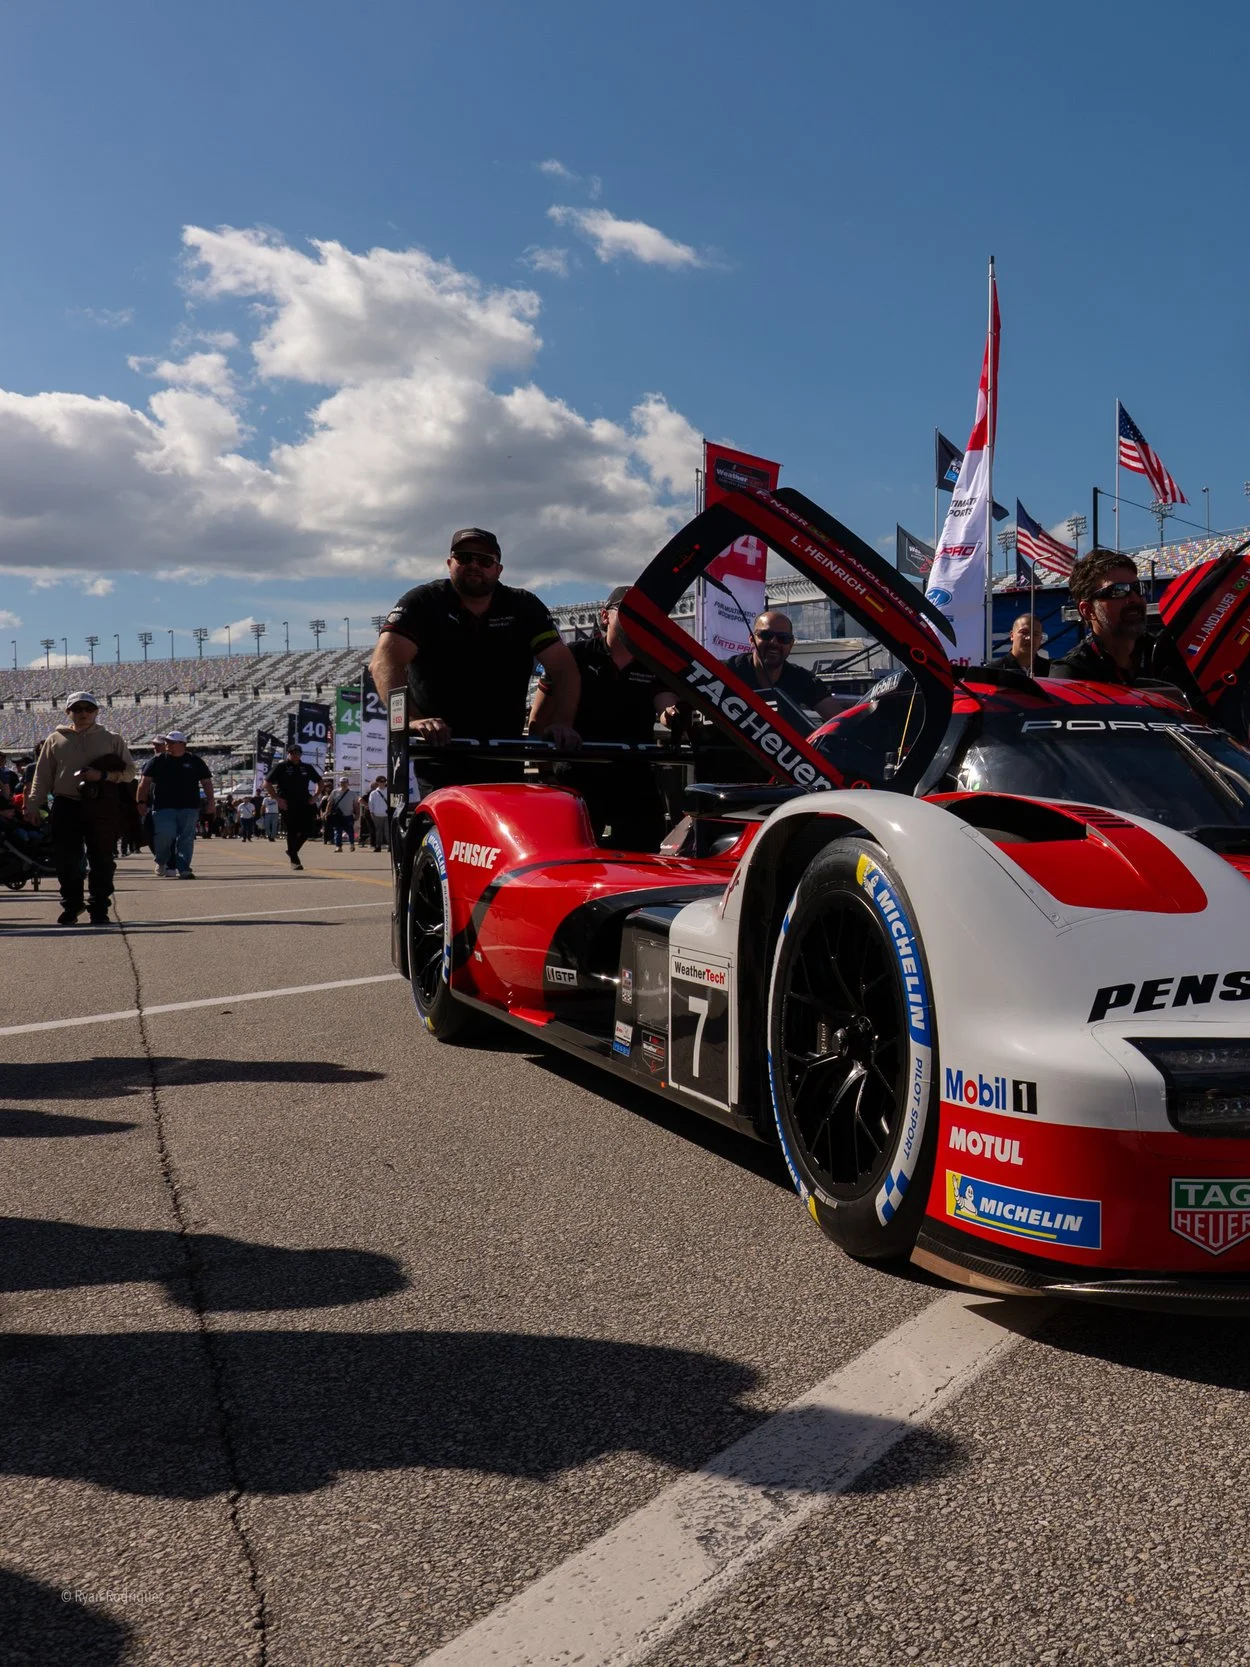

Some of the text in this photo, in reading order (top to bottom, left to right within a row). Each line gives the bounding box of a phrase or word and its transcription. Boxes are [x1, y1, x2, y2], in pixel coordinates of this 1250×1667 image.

[770, 499, 809, 527] NASR
[790, 535, 866, 596] L. HEINRICH
[848, 557, 914, 615] ANDLAUER
[1201, 592, 1238, 635] ANDLAUER
[302, 721, 326, 738] 40
[449, 840, 502, 870] PENSKE
[555, 971, 575, 982] GTP
[674, 961, 725, 985] WeatherTech
[875, 888, 927, 1031] MICHELIN
[688, 995, 709, 1078] 7
[903, 1056, 924, 1160] PILOT SPORT
[946, 1068, 1006, 1110] Mobil
[949, 1126, 1023, 1166] MOTUL
[979, 1196, 1084, 1232] MICHELIN
